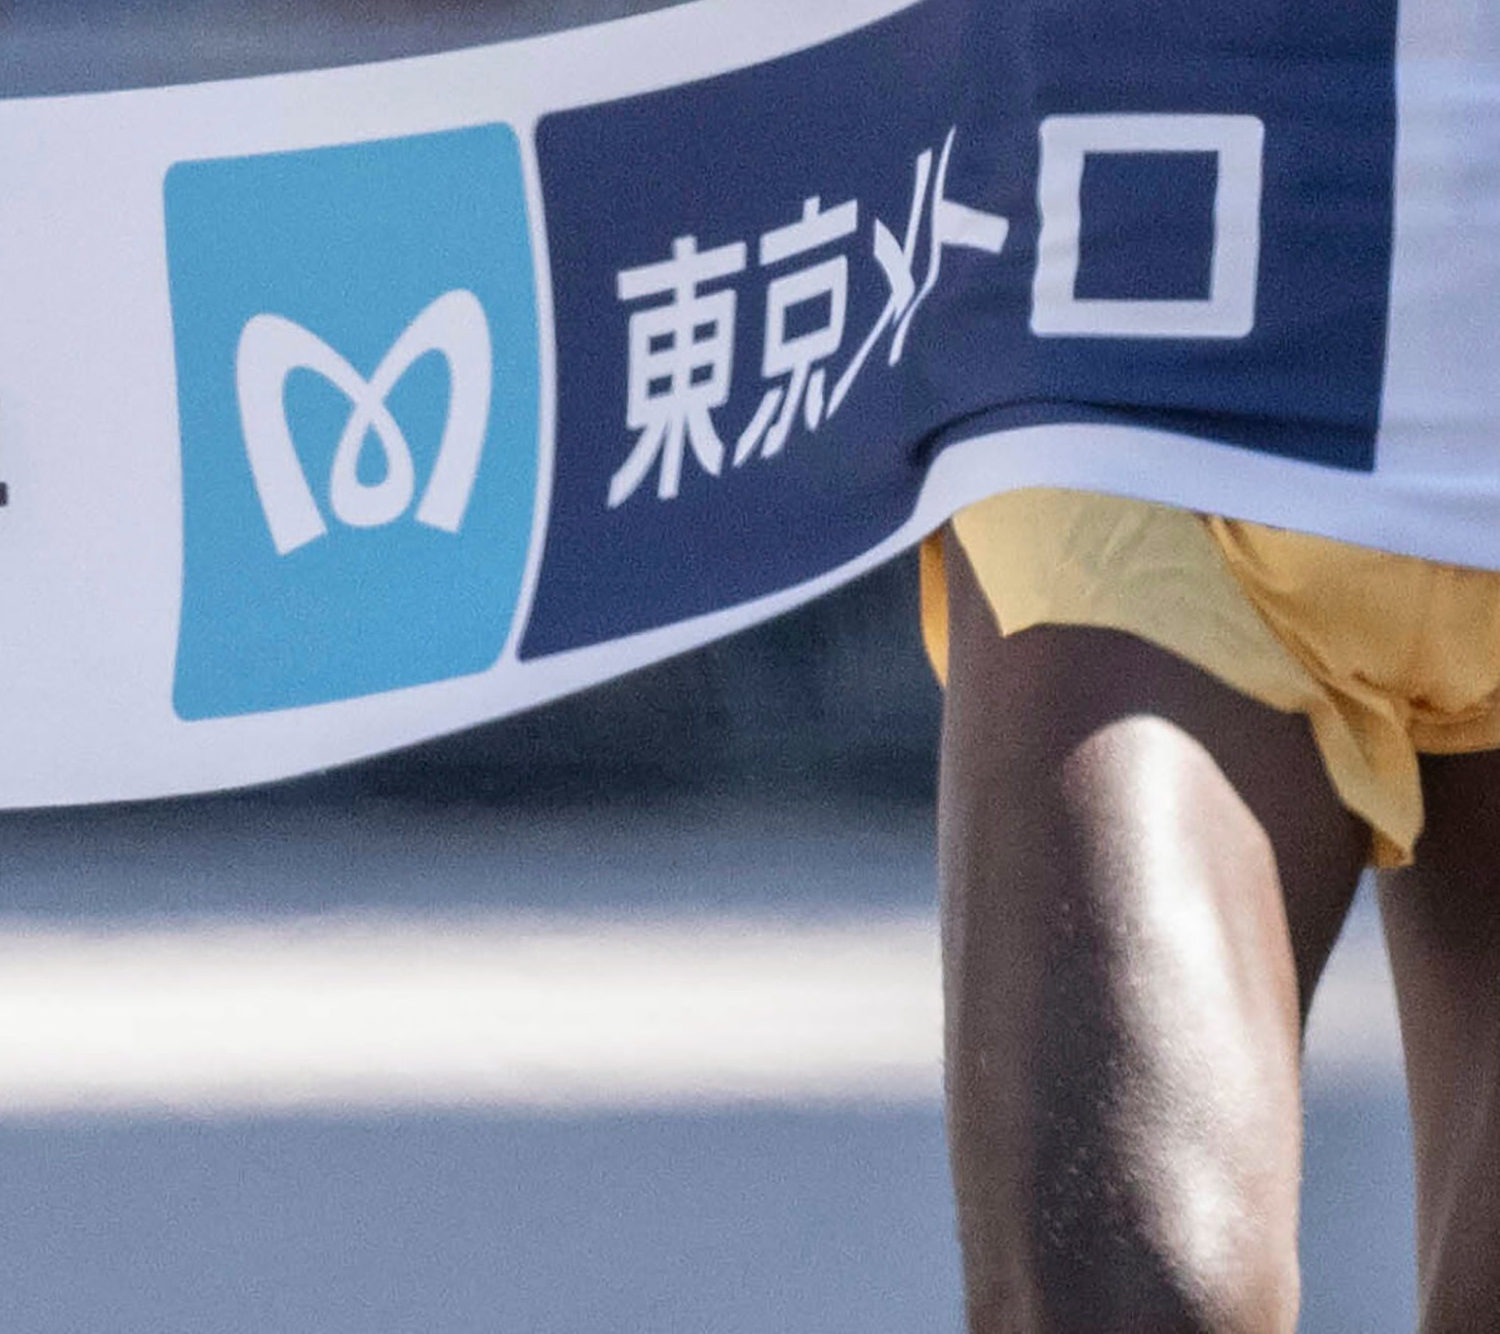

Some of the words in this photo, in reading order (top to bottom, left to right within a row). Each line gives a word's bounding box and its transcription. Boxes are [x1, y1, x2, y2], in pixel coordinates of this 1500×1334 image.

[607, 113, 1266, 508] 東京メトロ
